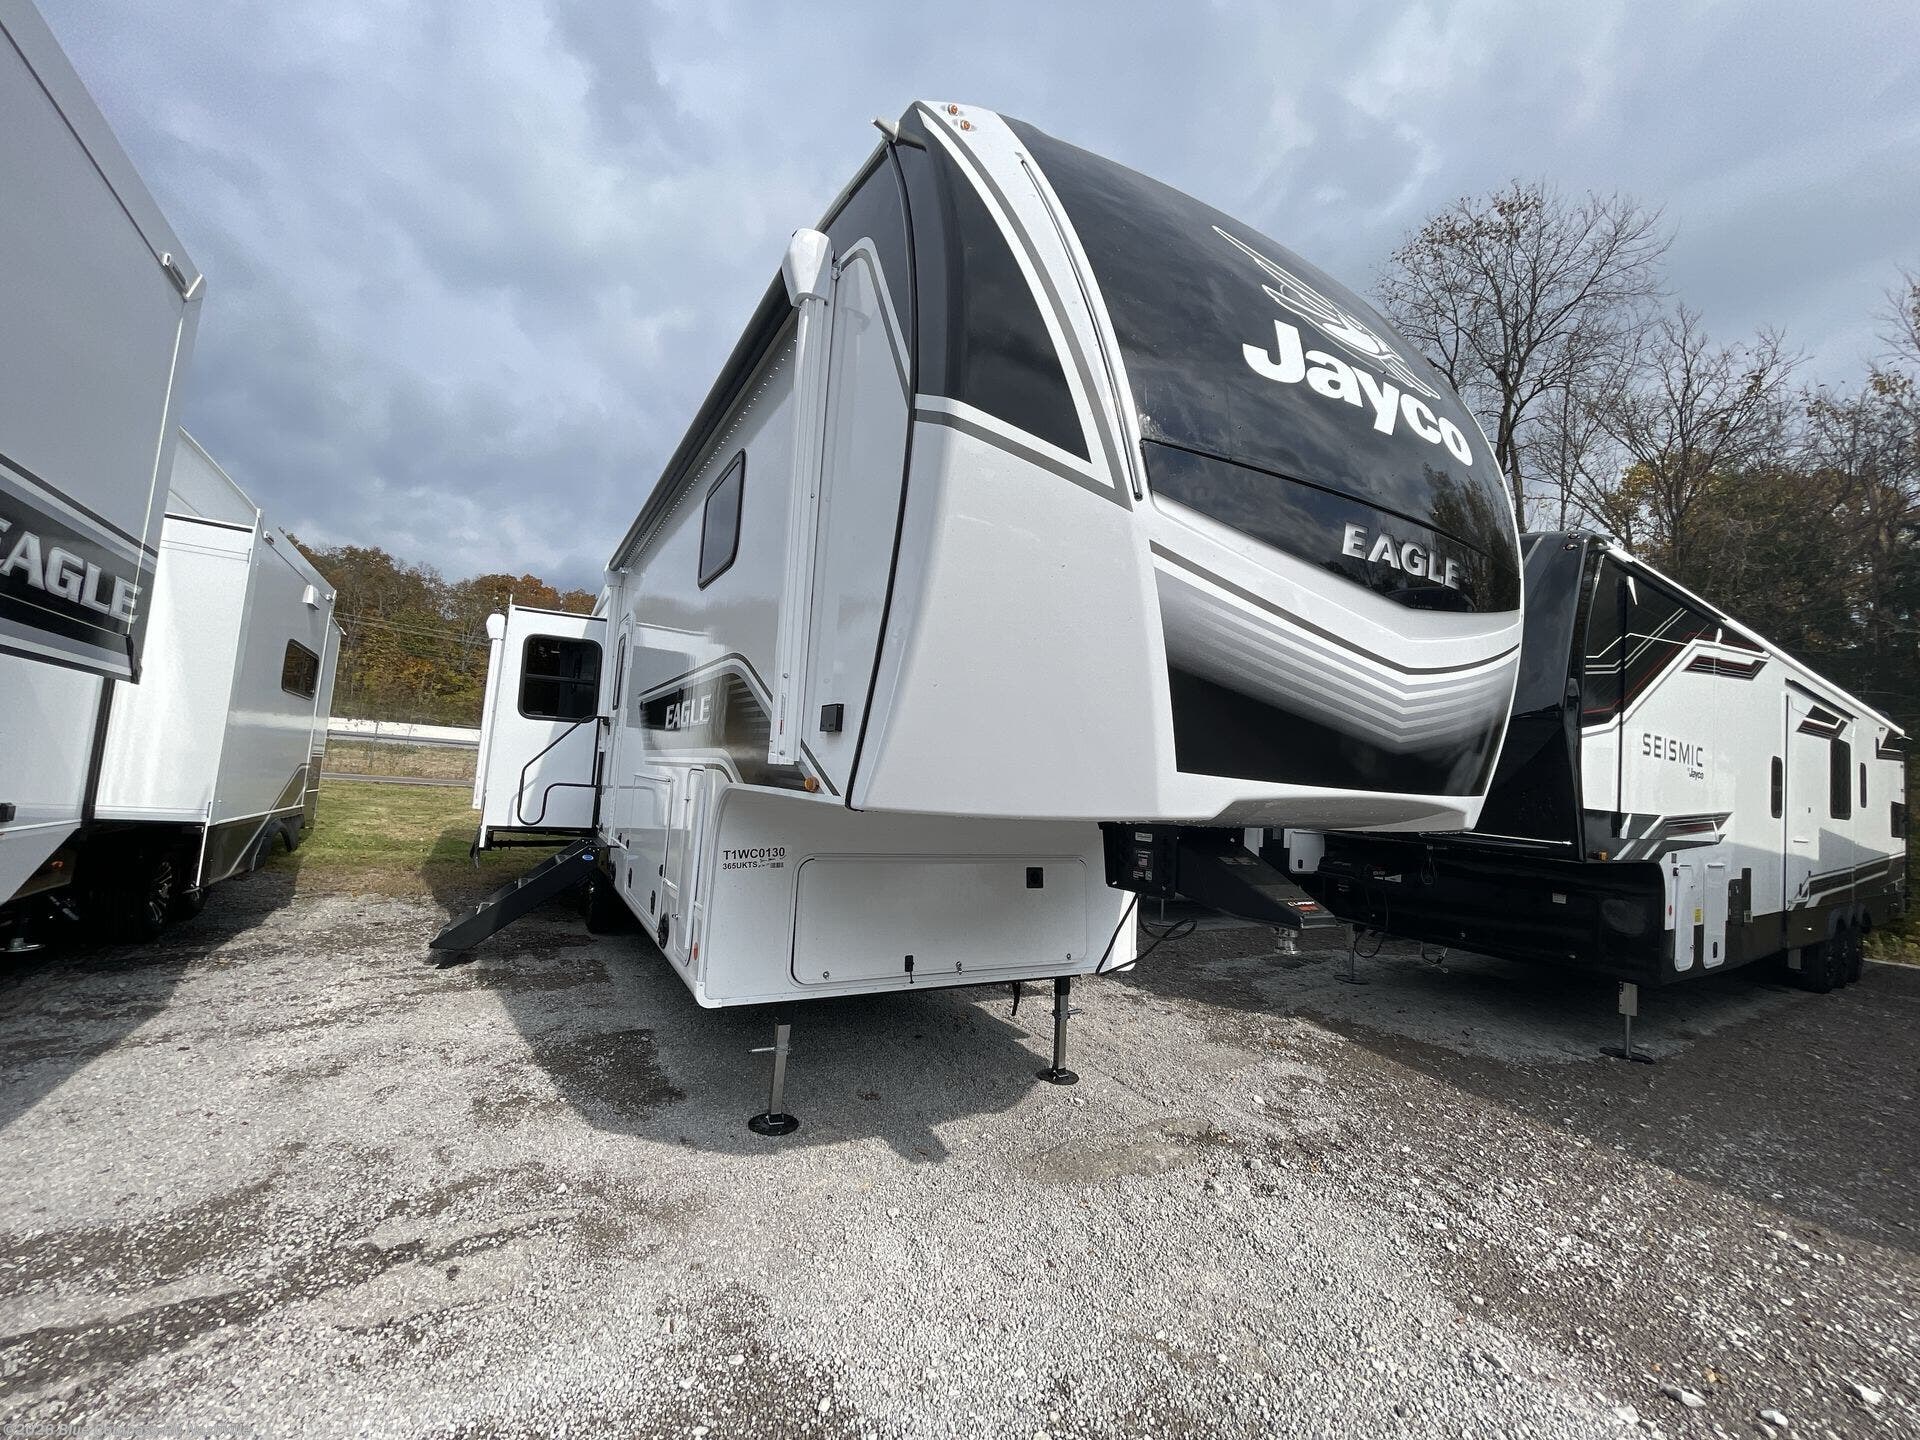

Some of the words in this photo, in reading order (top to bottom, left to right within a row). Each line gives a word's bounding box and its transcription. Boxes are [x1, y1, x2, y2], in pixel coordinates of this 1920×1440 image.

[1242, 319, 1473, 466] Jayco
[1342, 522, 1461, 590] EAGLE
[665, 694, 712, 730] EAGLE
[1642, 733, 1703, 767] SEISMIC
[1689, 768, 1704, 780] Jayco
[722, 861, 758, 870] 365UKTS
[723, 847, 785, 860] T1WC0130
